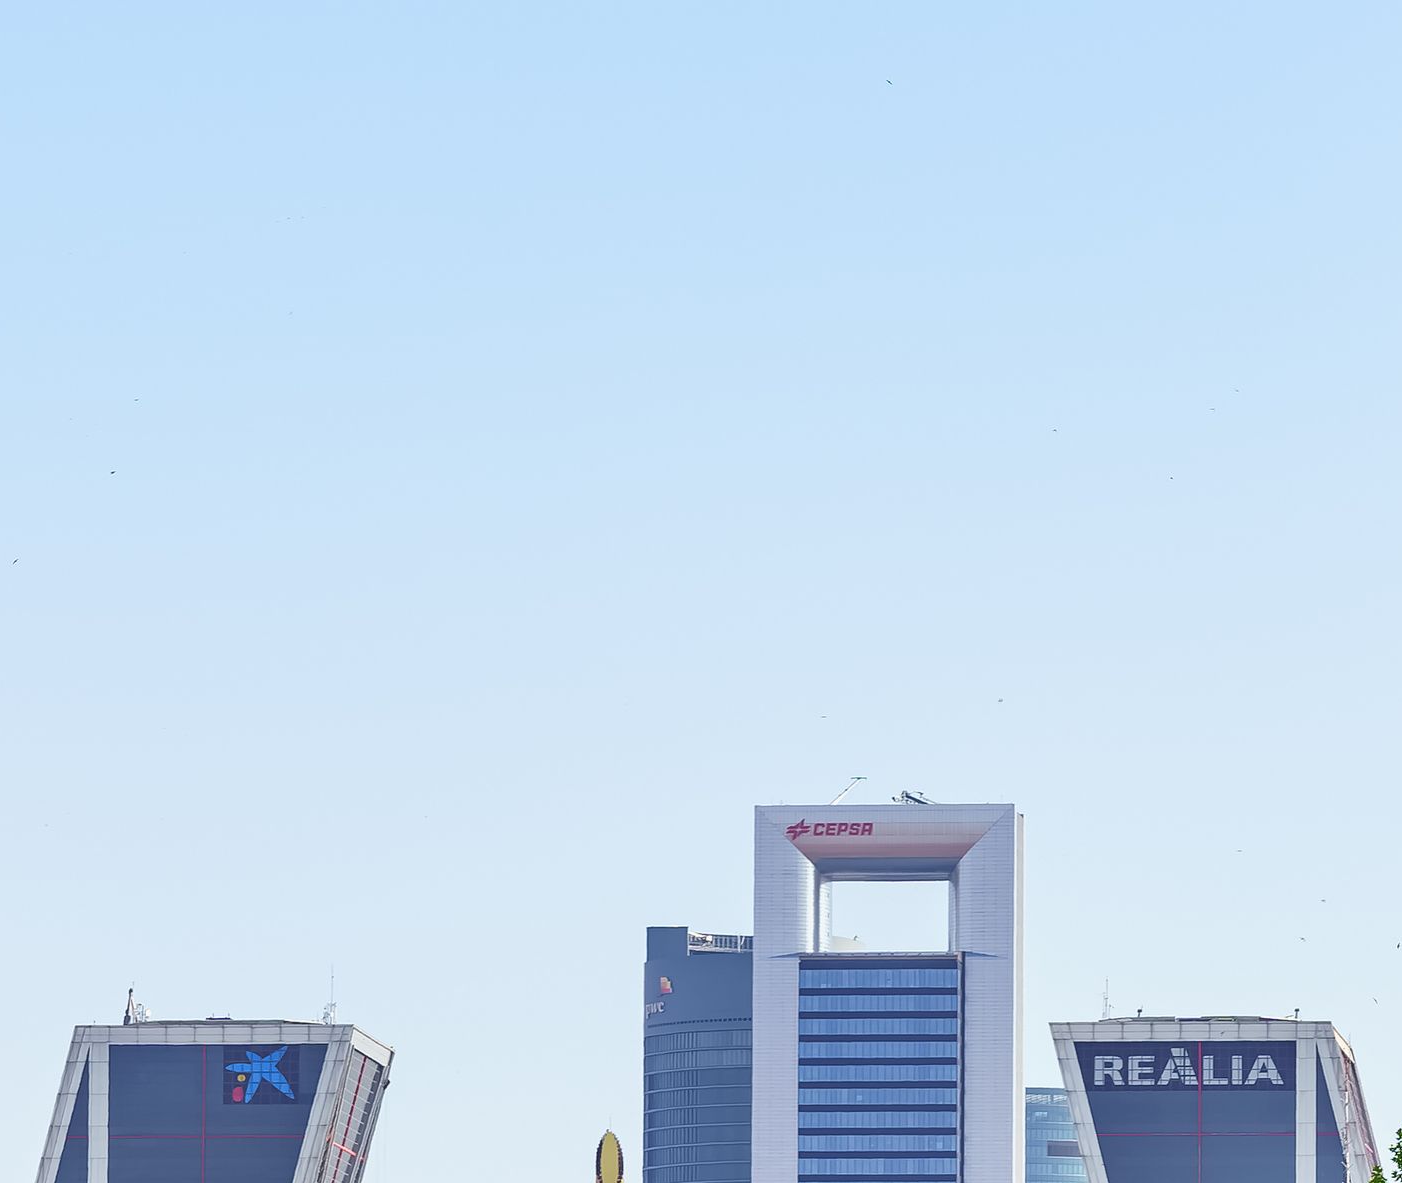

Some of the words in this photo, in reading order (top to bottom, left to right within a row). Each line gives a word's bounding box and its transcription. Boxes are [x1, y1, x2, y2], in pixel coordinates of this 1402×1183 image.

[813, 822, 873, 836] CEPSA
[645, 1002, 665, 1020] pwc
[1093, 1047, 1285, 1086] REALIA
